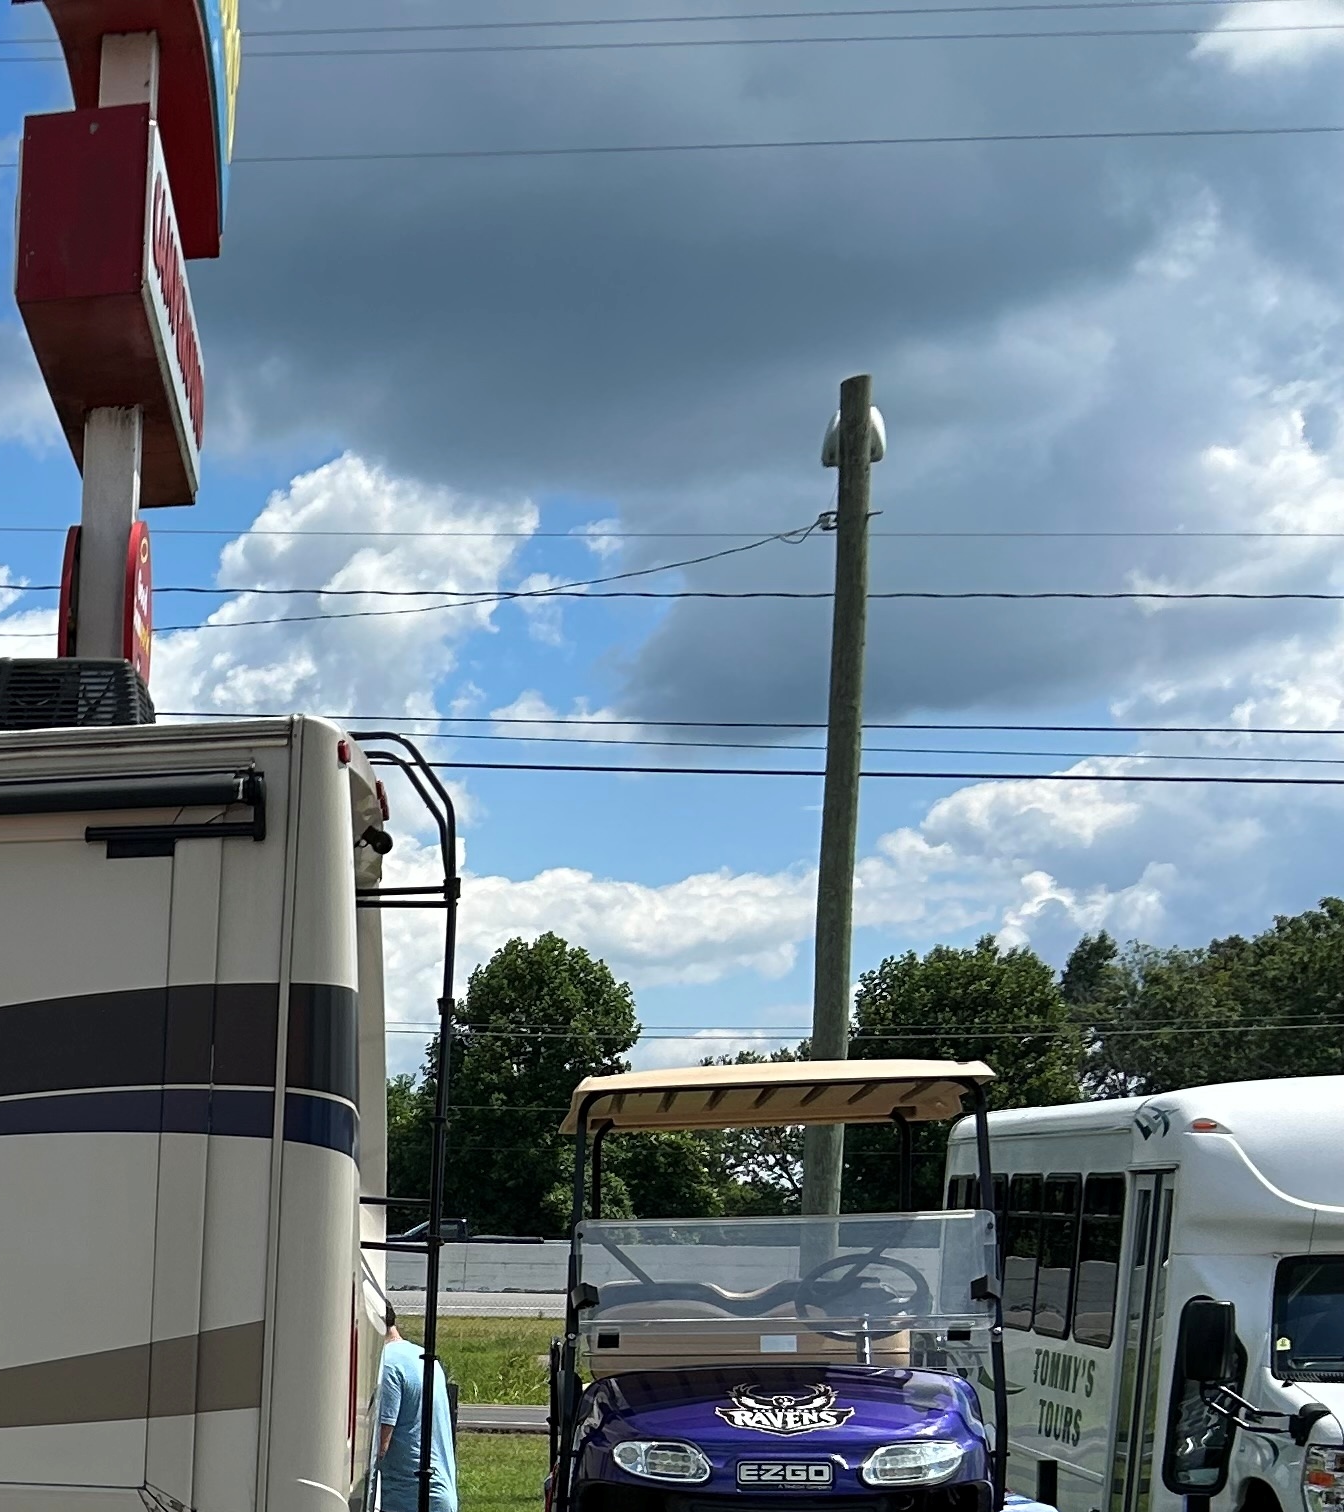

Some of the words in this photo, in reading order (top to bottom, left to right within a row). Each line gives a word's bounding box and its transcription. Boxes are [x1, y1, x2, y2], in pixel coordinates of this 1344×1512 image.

[1033, 1348, 1096, 1398] TOMMY'S
[728, 1410, 838, 1429] RAVENS
[1038, 1398, 1082, 1447] TOURS
